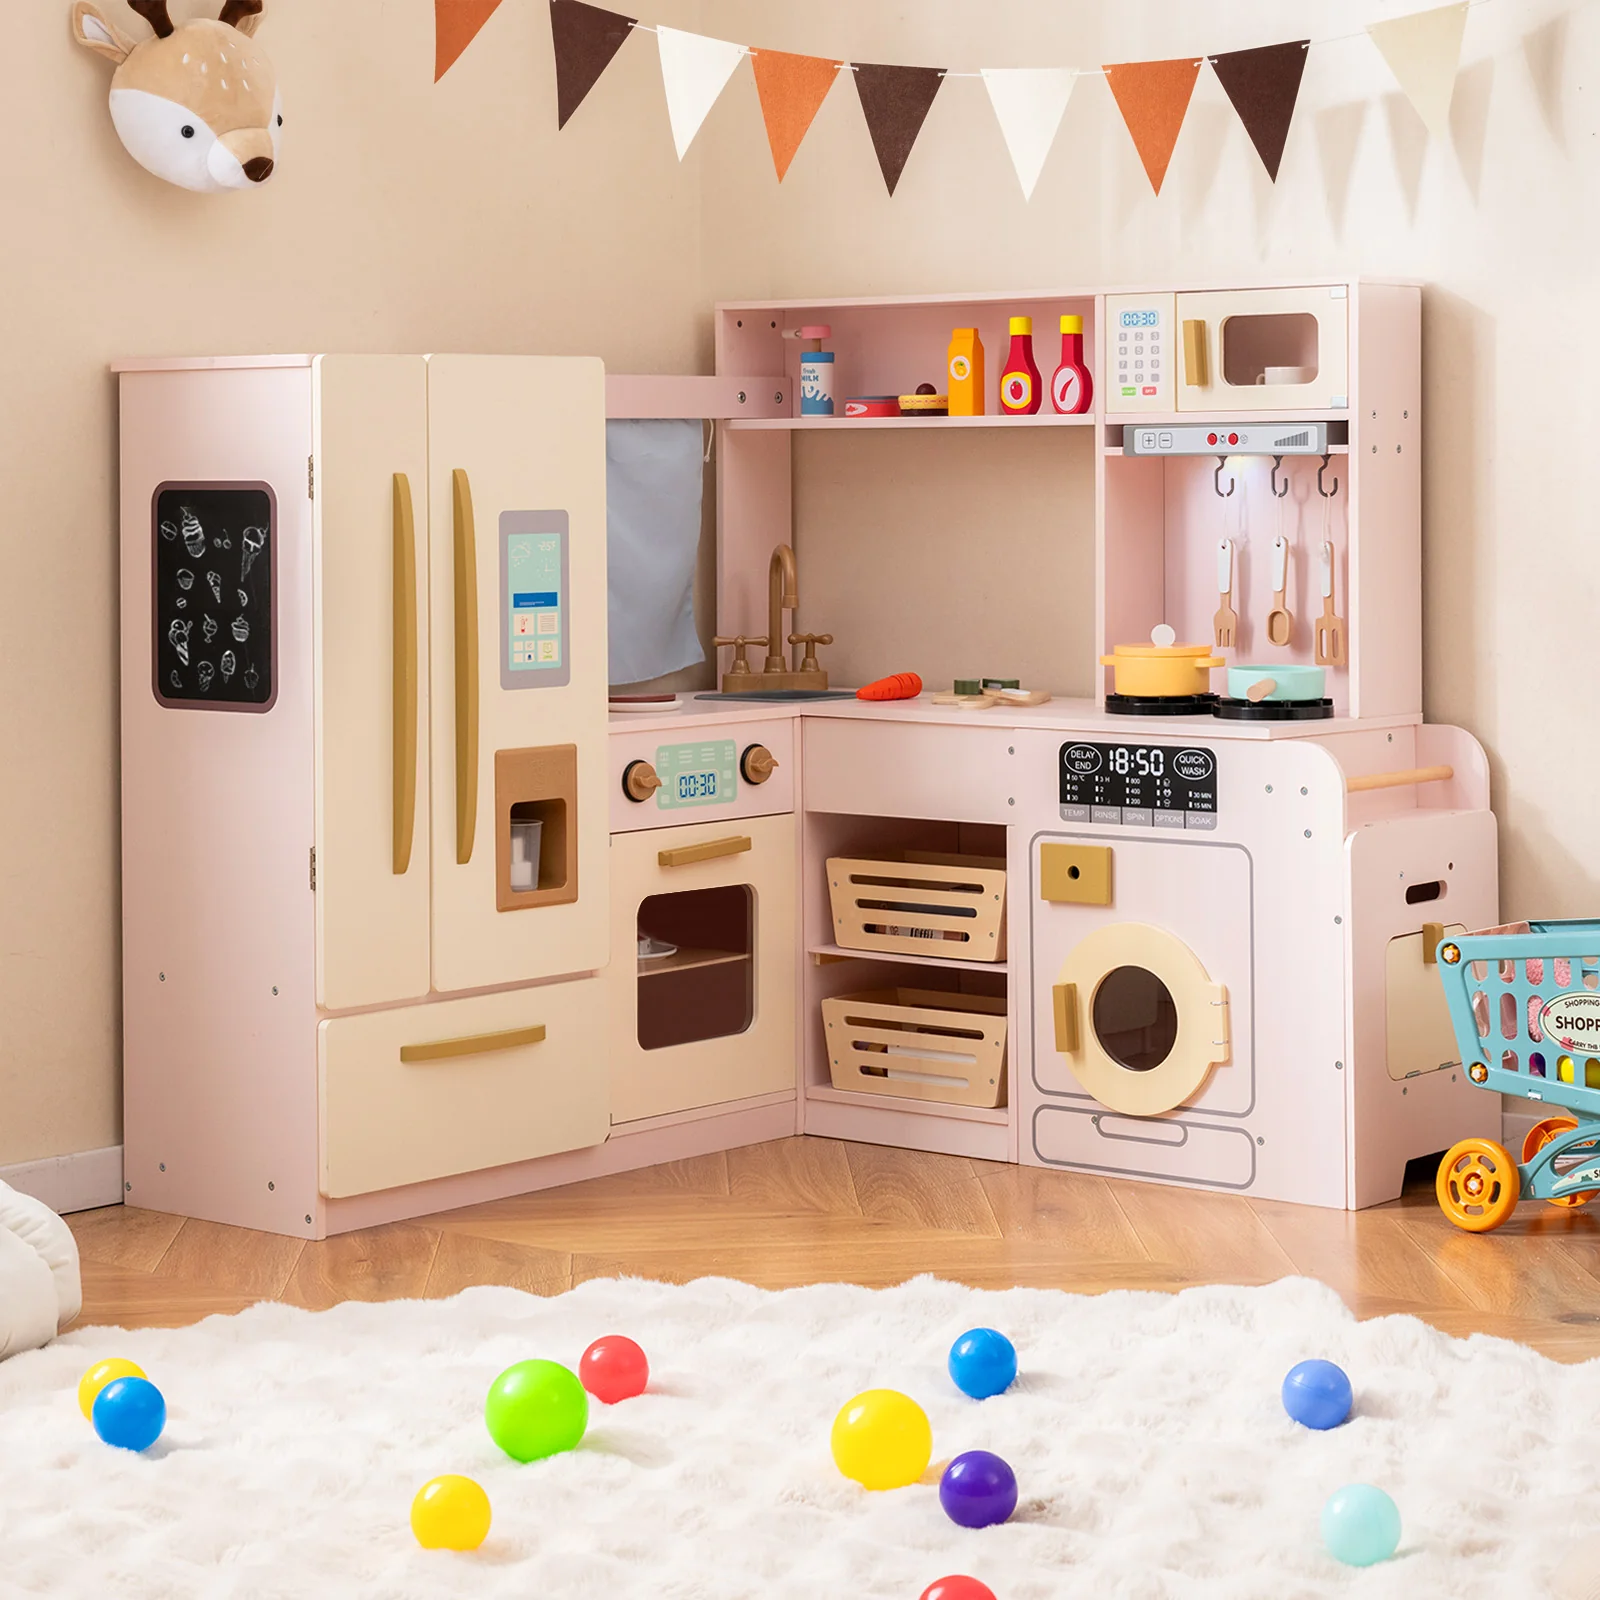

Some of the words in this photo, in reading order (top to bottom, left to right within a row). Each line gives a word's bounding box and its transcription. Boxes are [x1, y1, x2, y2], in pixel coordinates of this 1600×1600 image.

[1123, 312, 1156, 326] 00:30
[1070, 750, 1096, 758] DELAY
[1109, 748, 1164, 776] 18:50
[1179, 755, 1205, 764] QUICK
[1074, 761, 1092, 770] END
[1181, 766, 1206, 776] WASH
[679, 772, 716, 798] 00:30
[1064, 808, 1085, 816] TEMP
[1094, 811, 1118, 820] RINSE
[1126, 812, 1145, 821] SPIN
[1155, 814, 1183, 824] OPTIONS
[1189, 816, 1211, 825] SOAK
[1564, 999, 1600, 1008] SHOPPING
[1568, 1038, 1586, 1048] CARRY
